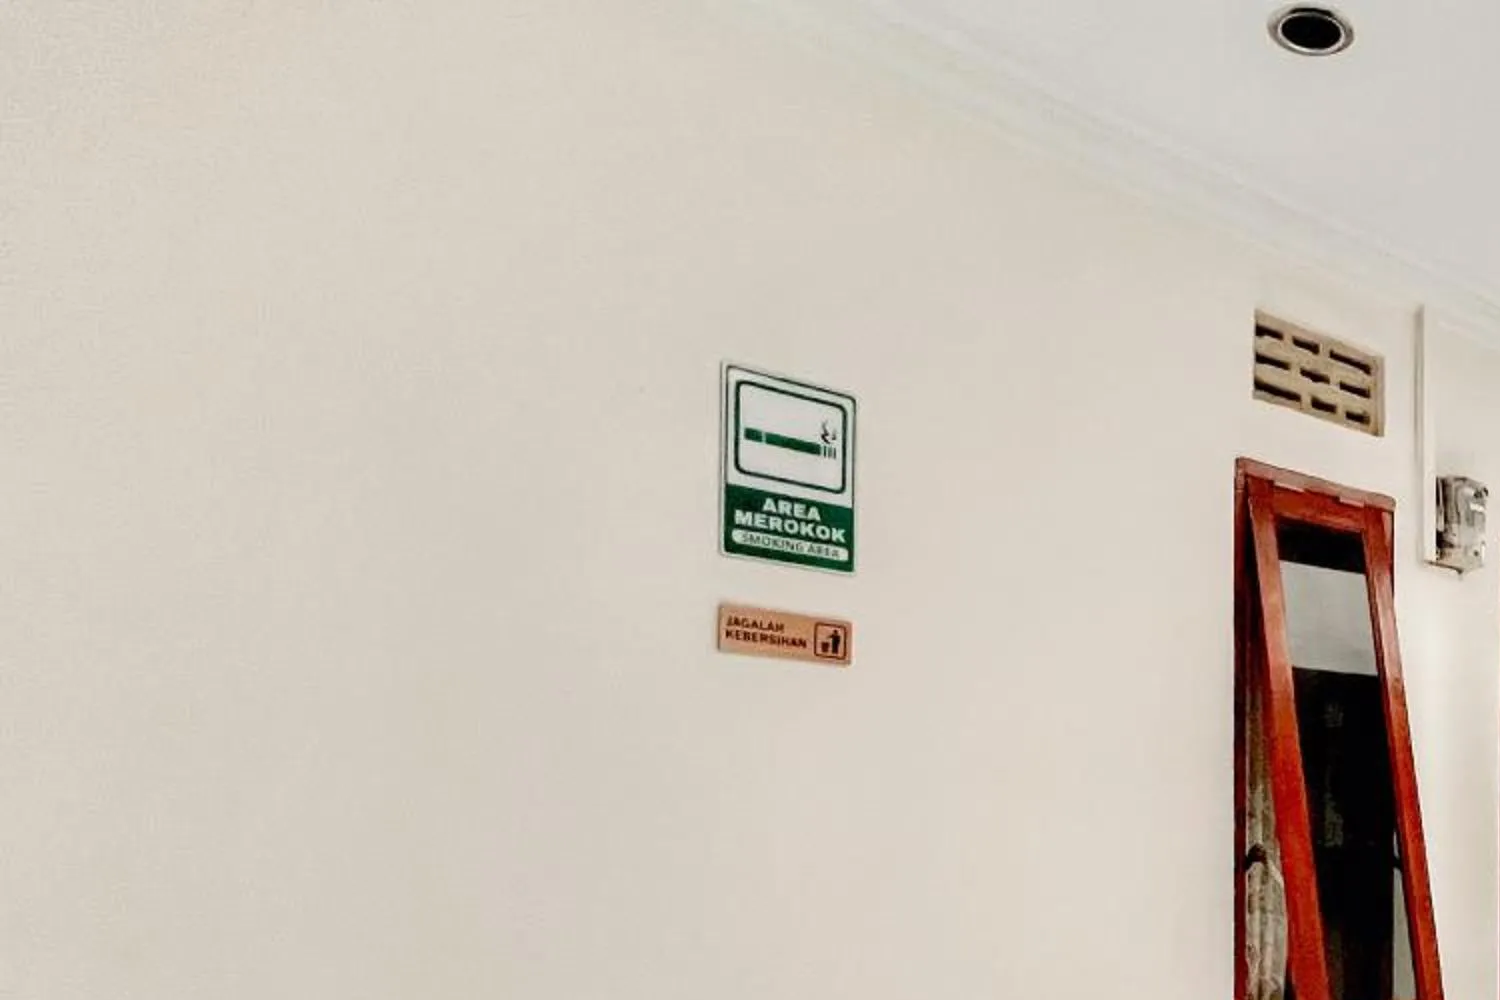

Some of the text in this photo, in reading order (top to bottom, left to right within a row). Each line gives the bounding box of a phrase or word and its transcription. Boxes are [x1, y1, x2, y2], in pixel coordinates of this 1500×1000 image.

[763, 497, 821, 521] AREA
[734, 509, 846, 543] MEROKOK
[742, 531, 803, 552] SMOKING
[726, 615, 785, 632] JAGALAH
[725, 629, 807, 648] KEBERSIHAN
